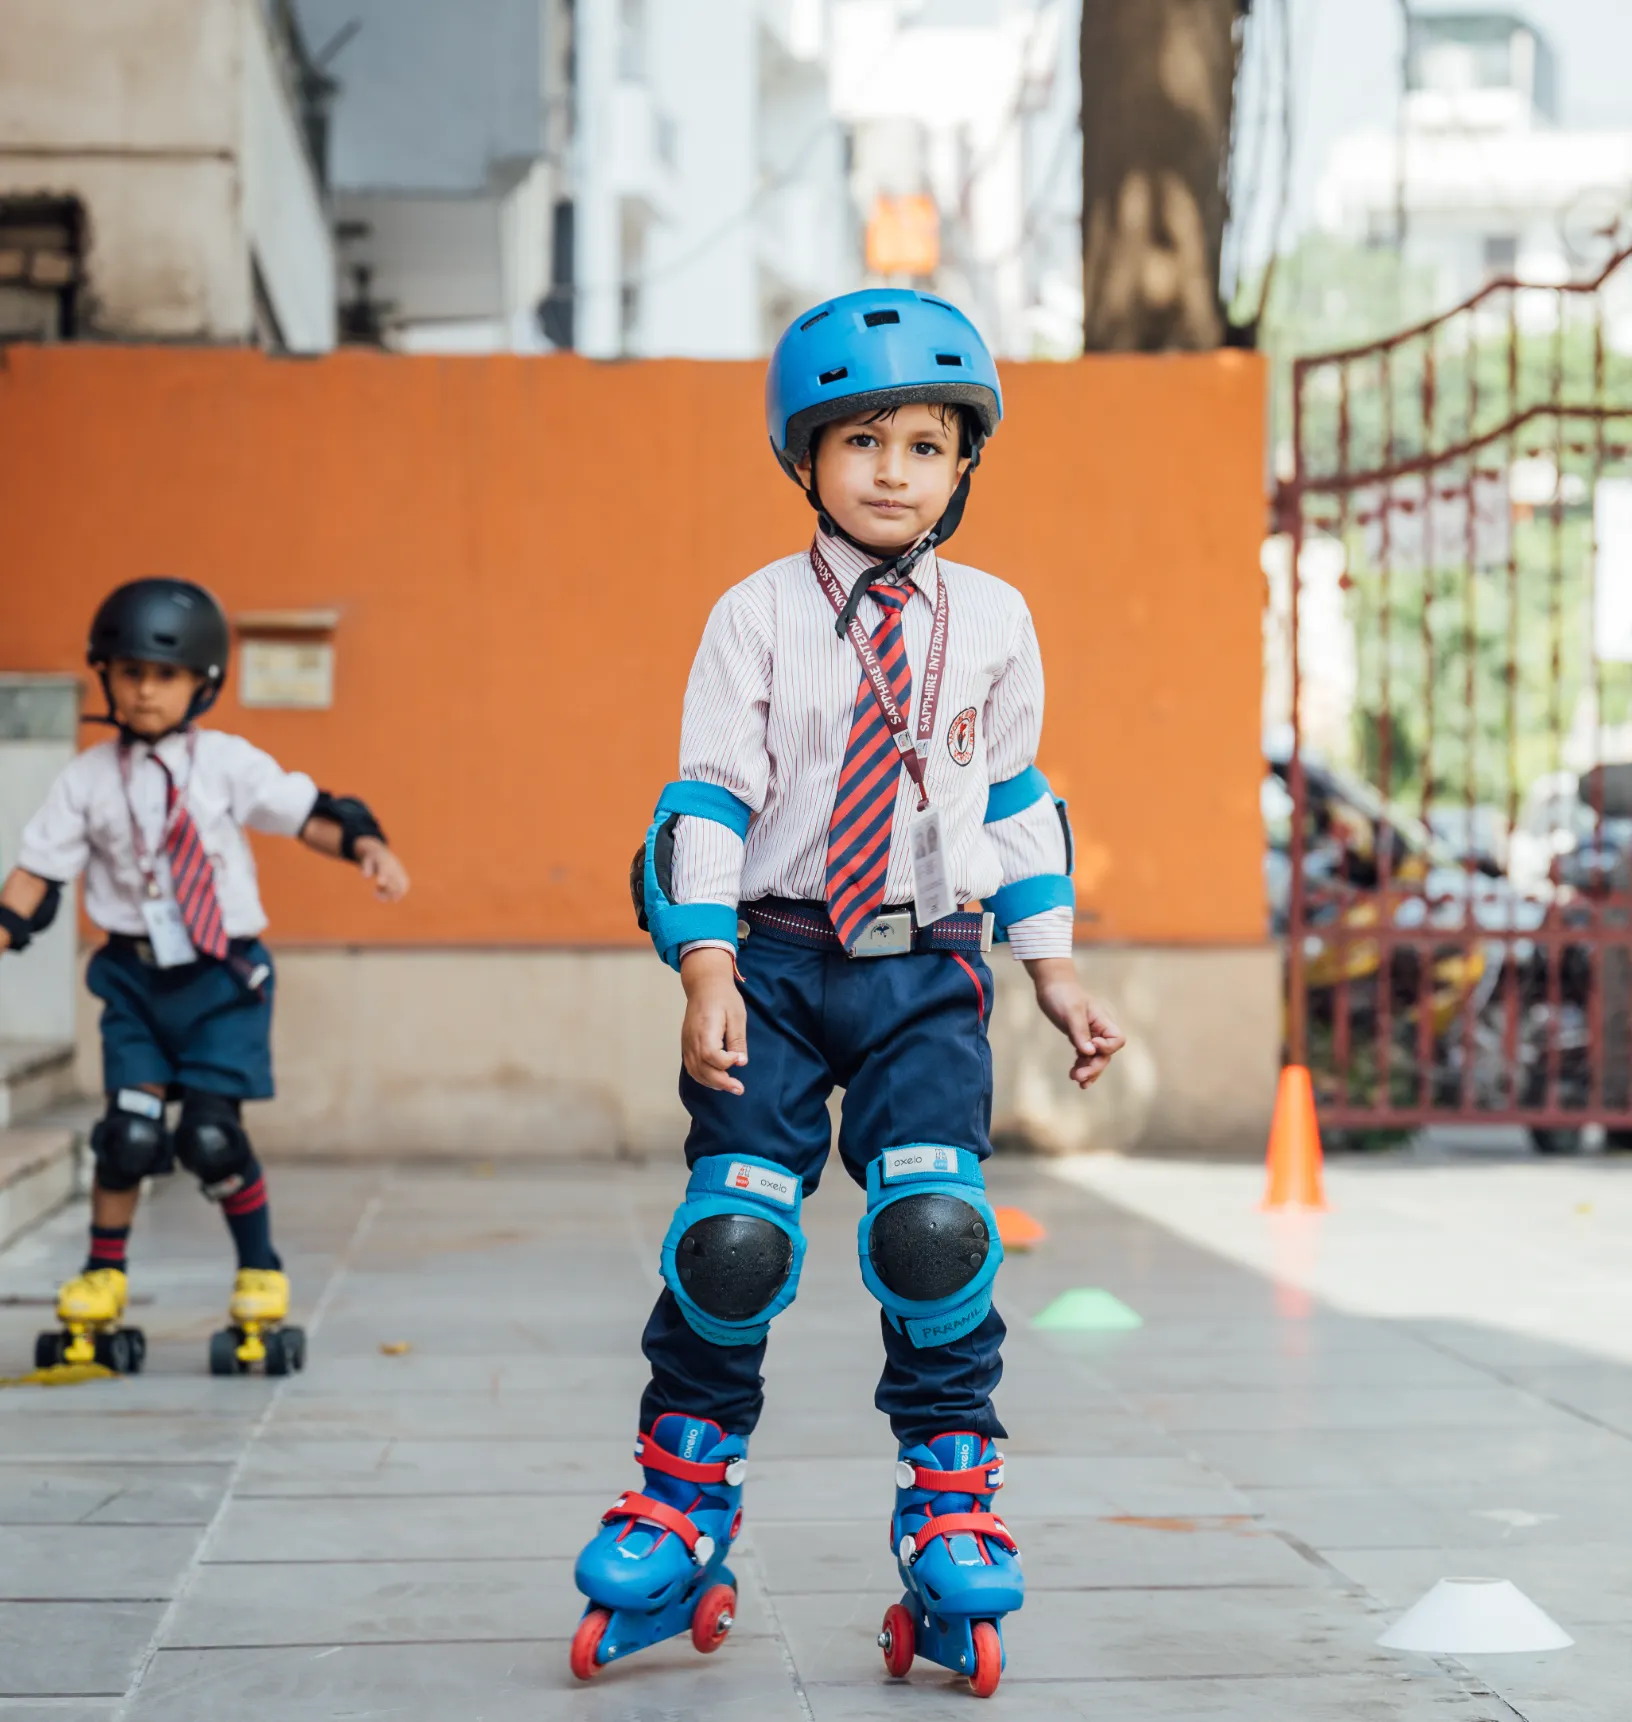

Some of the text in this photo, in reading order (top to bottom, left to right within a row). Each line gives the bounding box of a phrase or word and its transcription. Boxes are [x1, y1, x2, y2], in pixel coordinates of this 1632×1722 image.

[928, 585, 946, 671] INTERNATIONAL
[869, 665, 902, 725] SAPPHIRE
[920, 673, 938, 732] SAPPHIRE
[893, 1155, 923, 1167] oxelo
[760, 1179, 787, 1194] oxelo
[683, 1429, 699, 1459] oxelo
[960, 1444, 970, 1471] xelo
